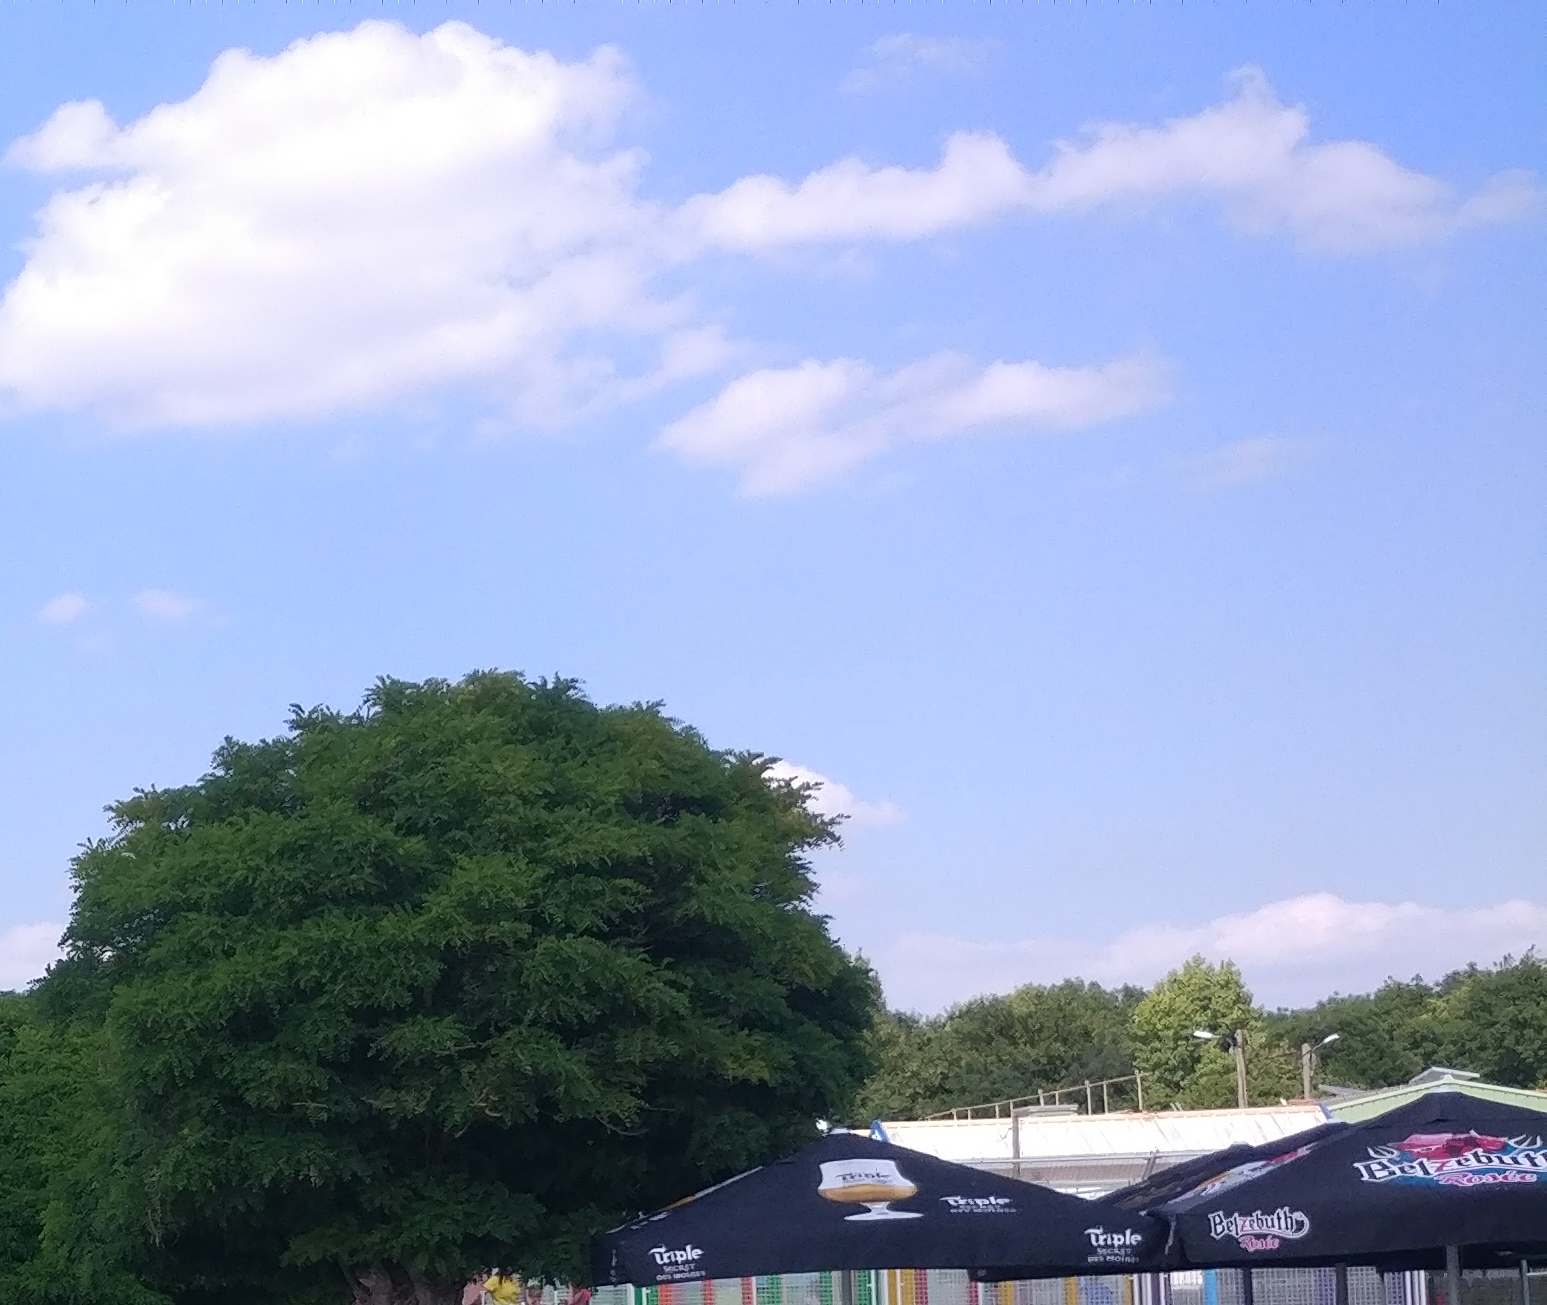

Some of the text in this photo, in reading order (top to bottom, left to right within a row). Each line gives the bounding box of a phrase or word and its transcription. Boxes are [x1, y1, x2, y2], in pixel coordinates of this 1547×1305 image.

[1353, 1148, 1547, 1183] Belzebut
[1084, 1225, 1143, 1248] Triple
[1208, 1206, 1309, 1240] Belzebuth
[648, 1244, 704, 1265] Triple
